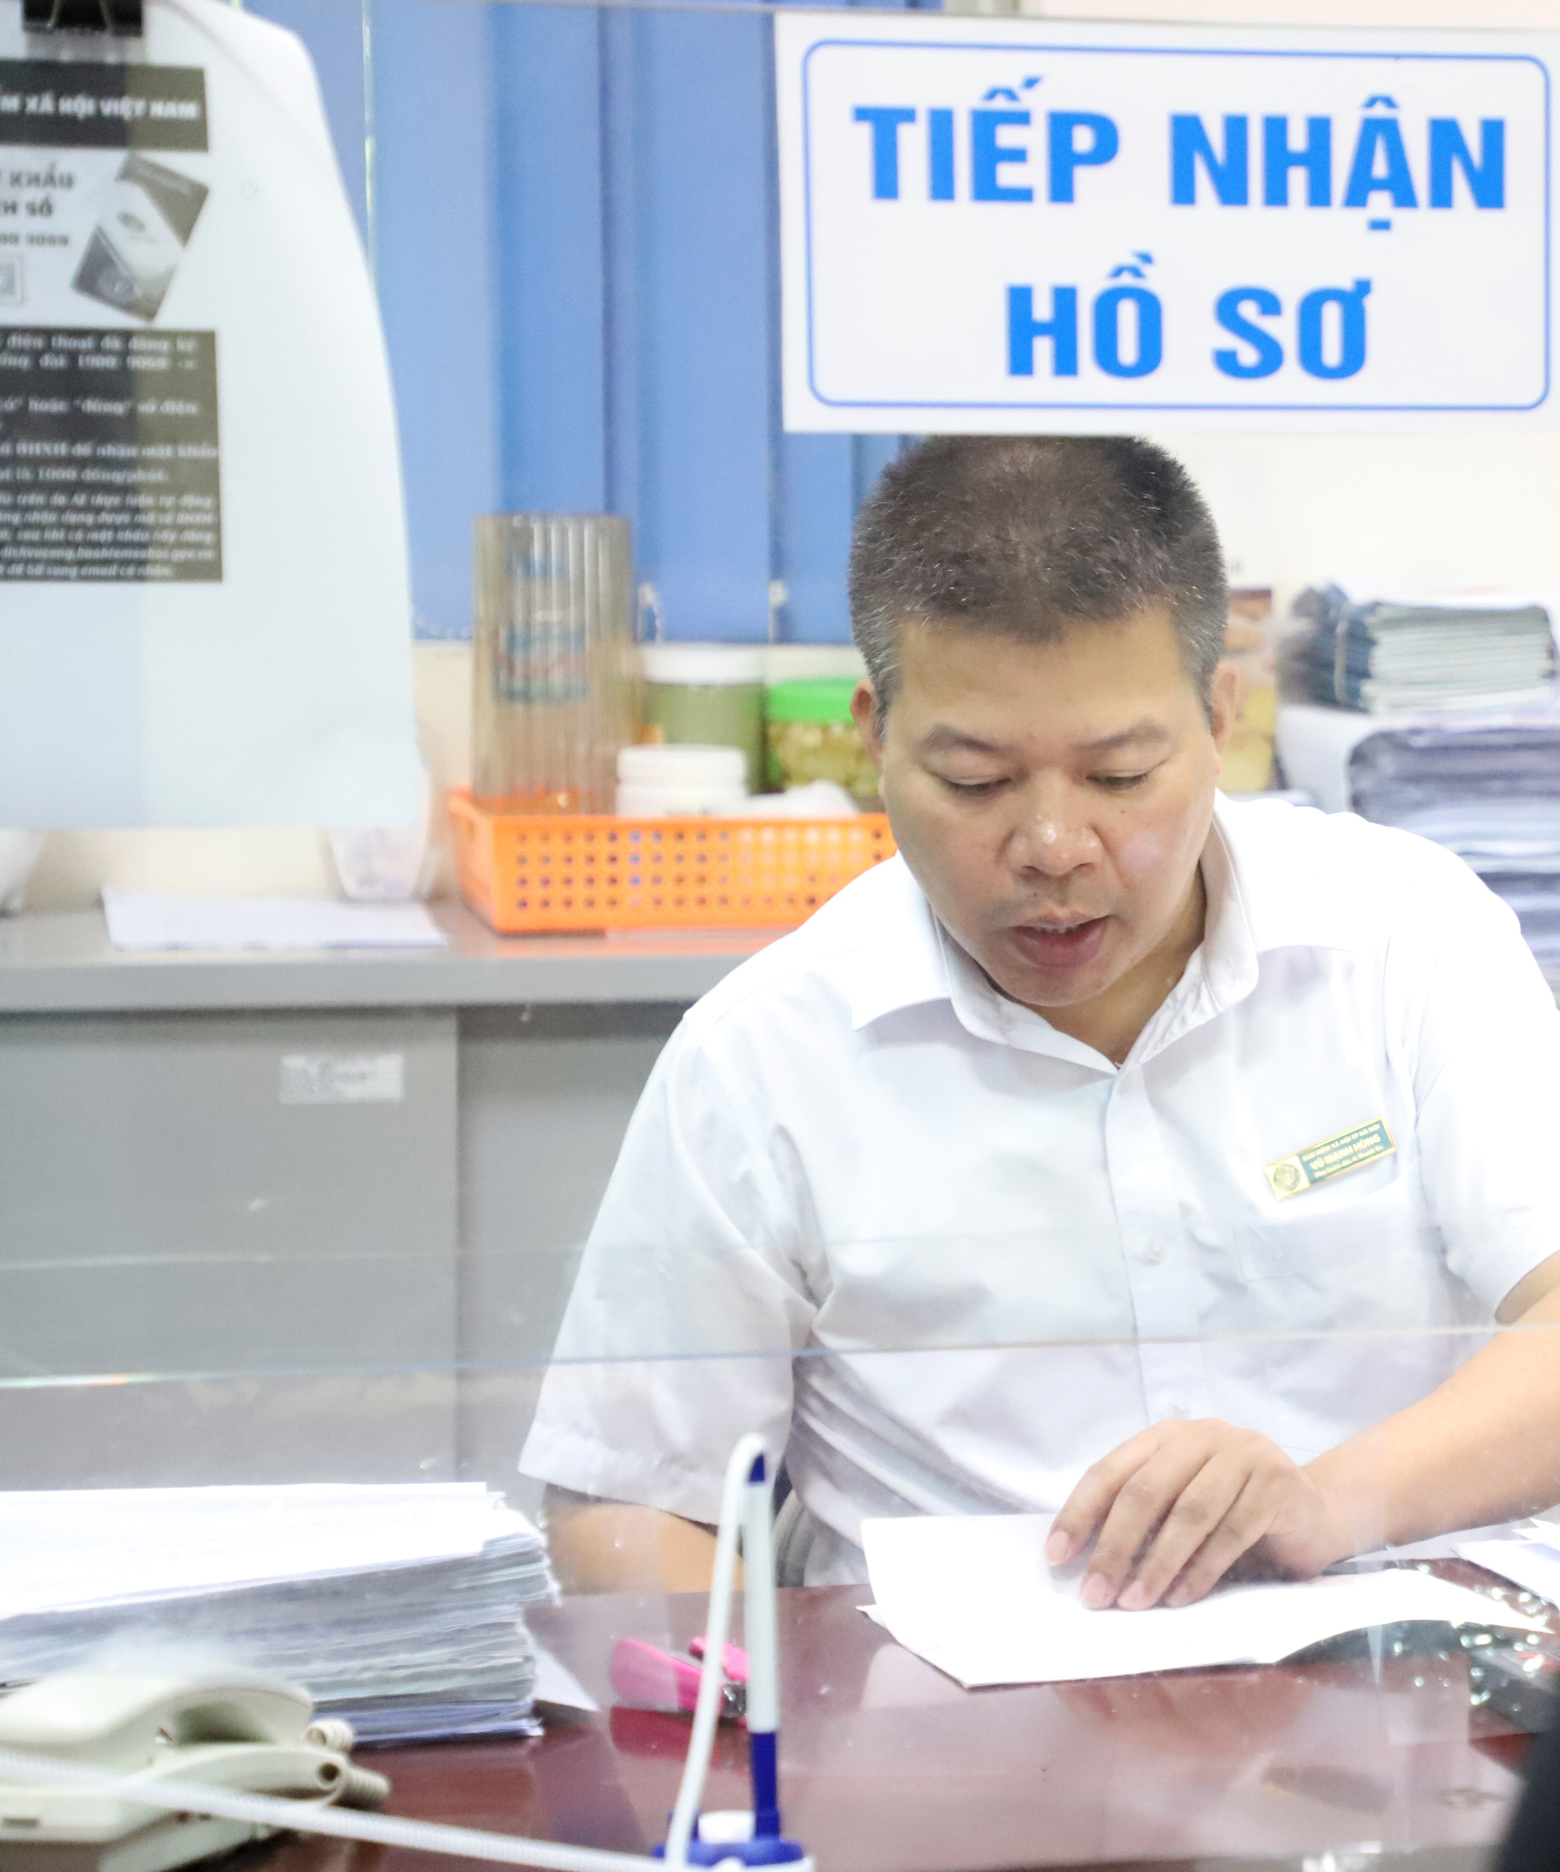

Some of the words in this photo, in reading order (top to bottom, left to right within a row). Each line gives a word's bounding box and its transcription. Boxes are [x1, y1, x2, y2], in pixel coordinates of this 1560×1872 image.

[59, 92, 95, 121] HỘI
[101, 96, 146, 121] VIỆT
[150, 101, 199, 119] NAM
[855, 79, 1118, 202] TIẾP
[1172, 97, 1504, 230] NHẬN
[1009, 254, 1162, 377] HỒ
[1216, 280, 1370, 379] SƠ
